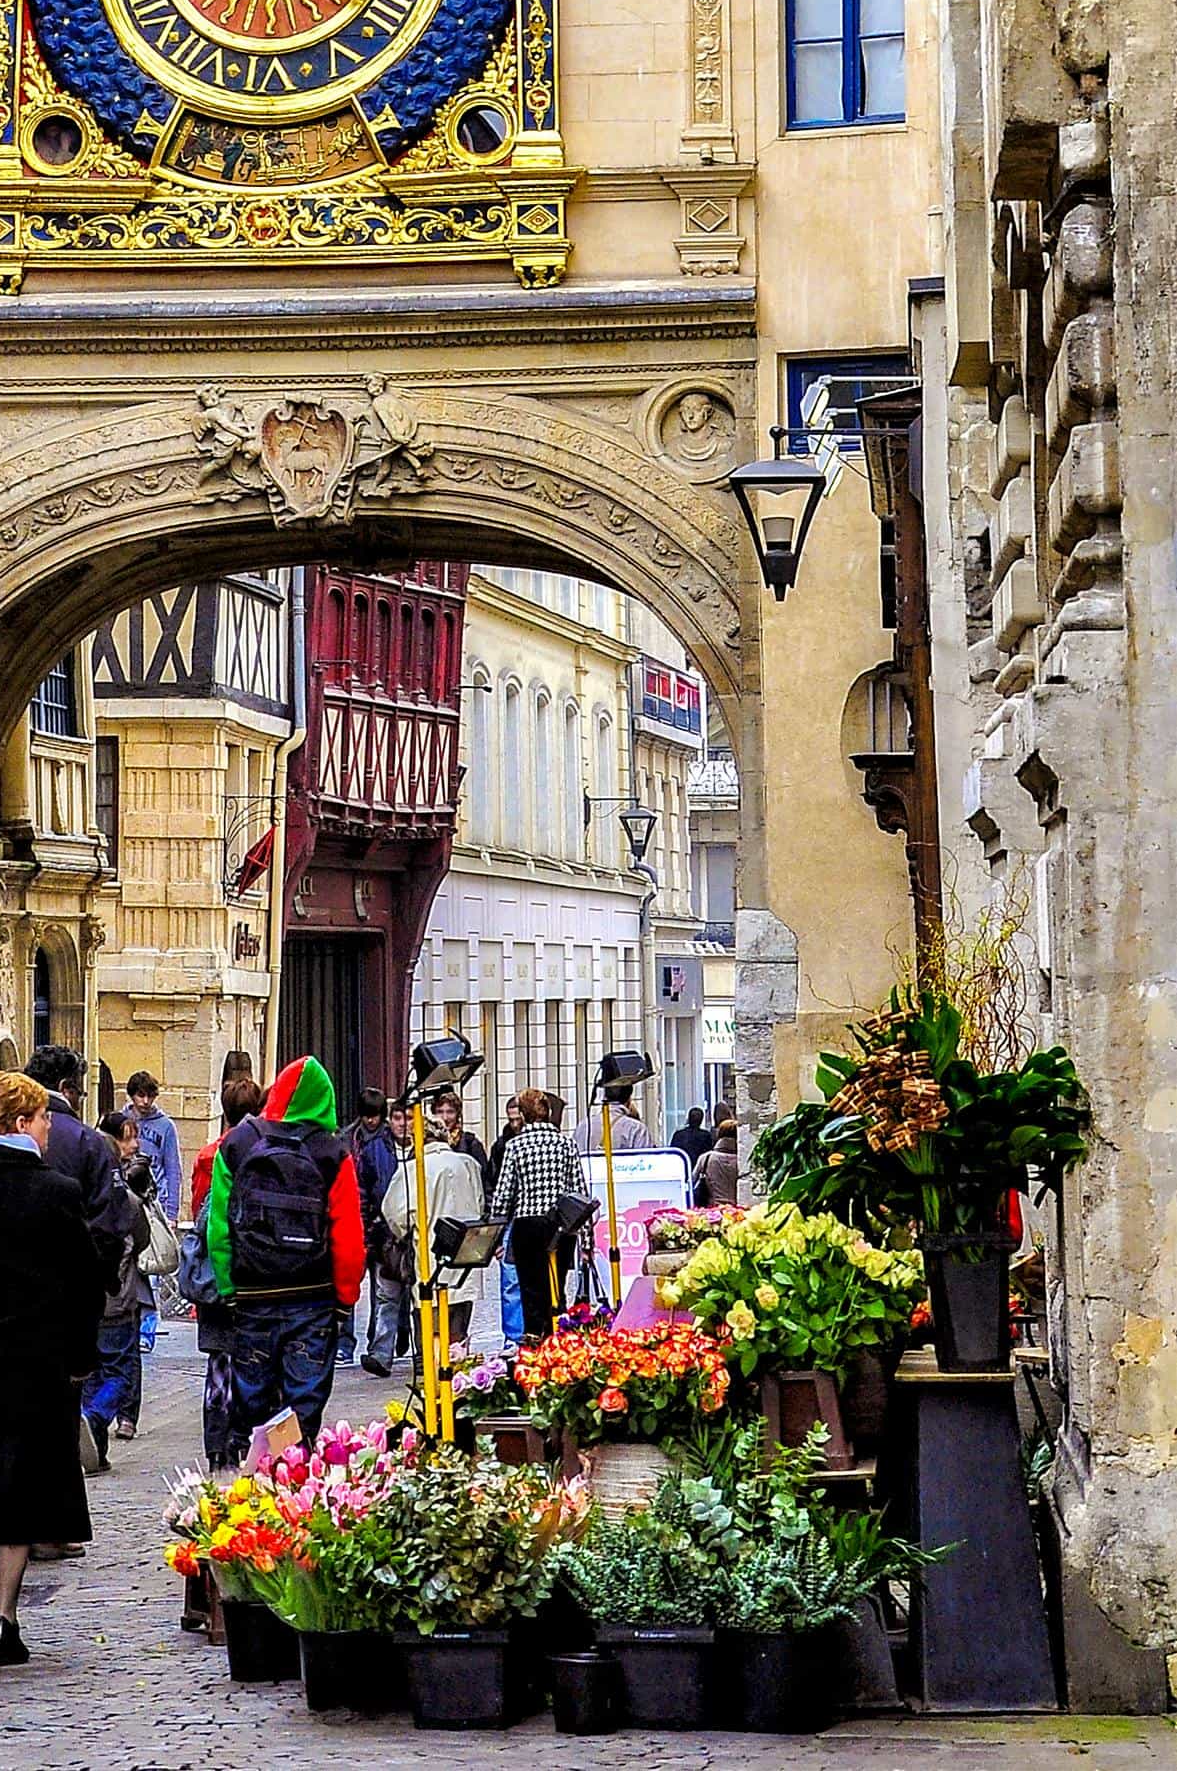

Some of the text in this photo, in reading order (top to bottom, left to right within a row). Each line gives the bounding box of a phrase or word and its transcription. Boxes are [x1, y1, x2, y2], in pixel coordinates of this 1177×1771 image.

[168, 35, 226, 87] VII
[242, 56, 298, 94] VI
[327, 39, 366, 78] V
